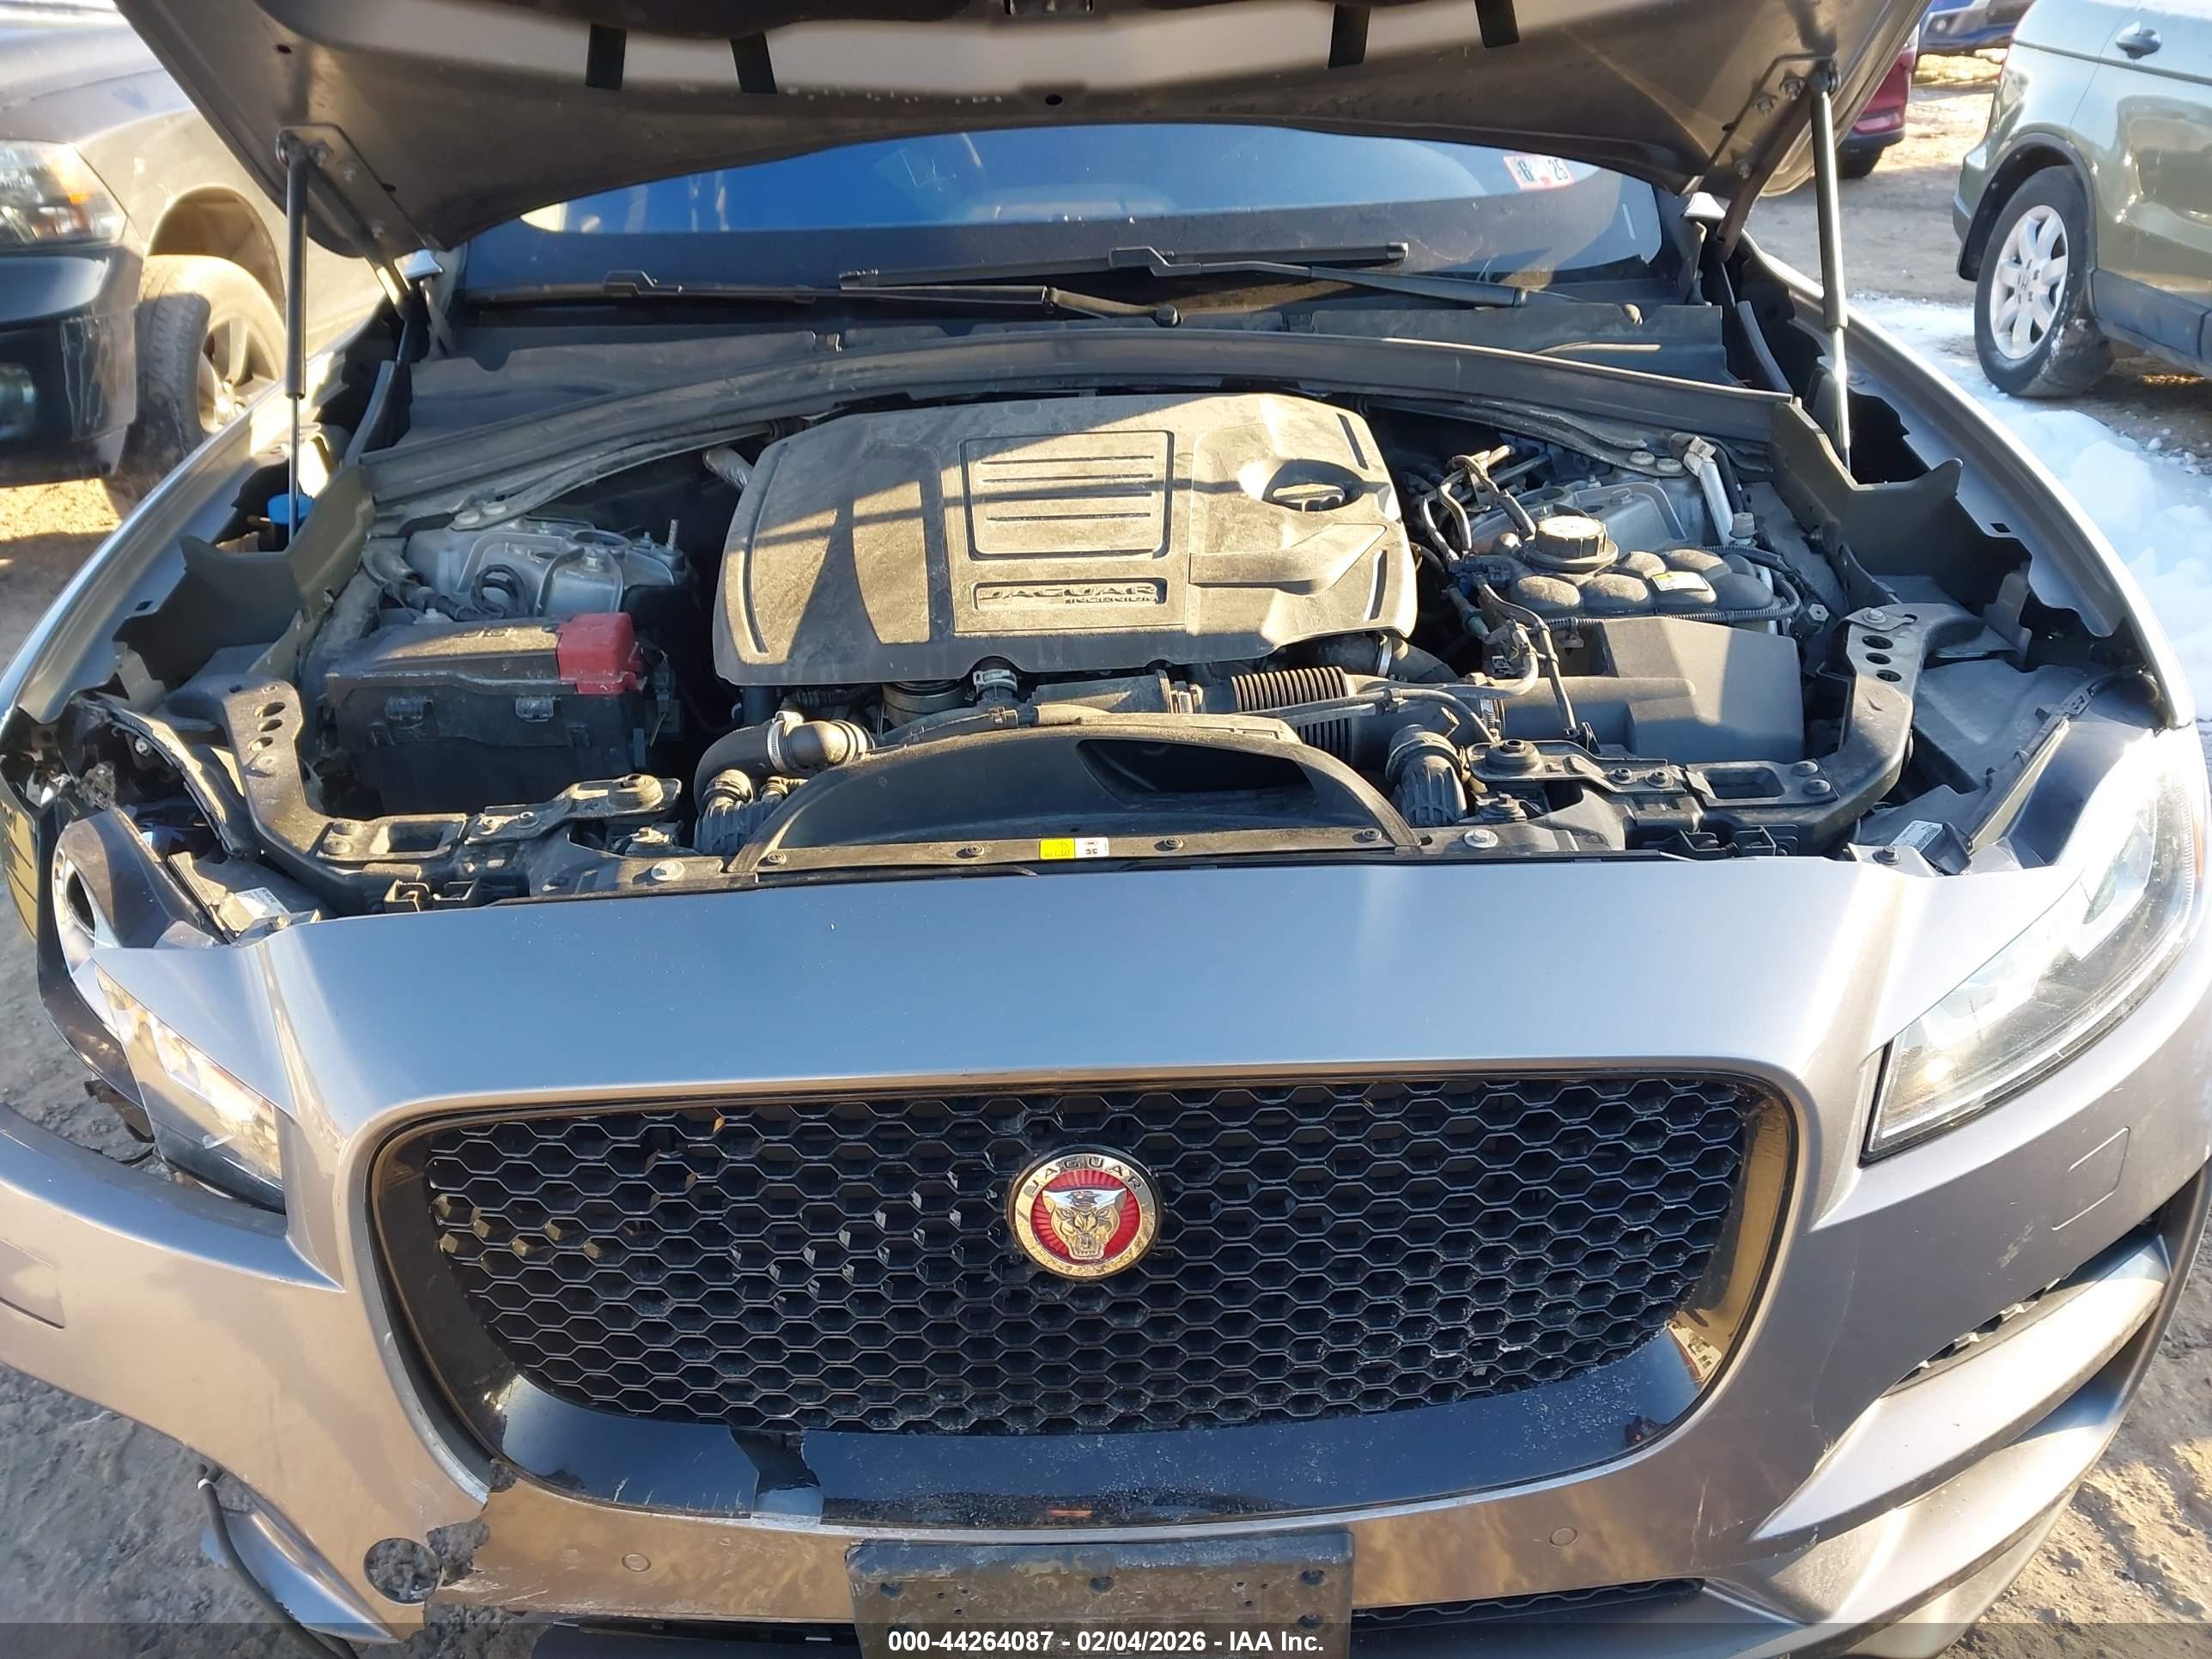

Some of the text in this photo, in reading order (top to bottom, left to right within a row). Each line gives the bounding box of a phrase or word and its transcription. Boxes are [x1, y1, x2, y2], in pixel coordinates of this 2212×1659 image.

[1547, 158, 1569, 180] 25
[978, 585, 1156, 601] JAGUAR
[1025, 1156, 1142, 1197] JAGUAR
